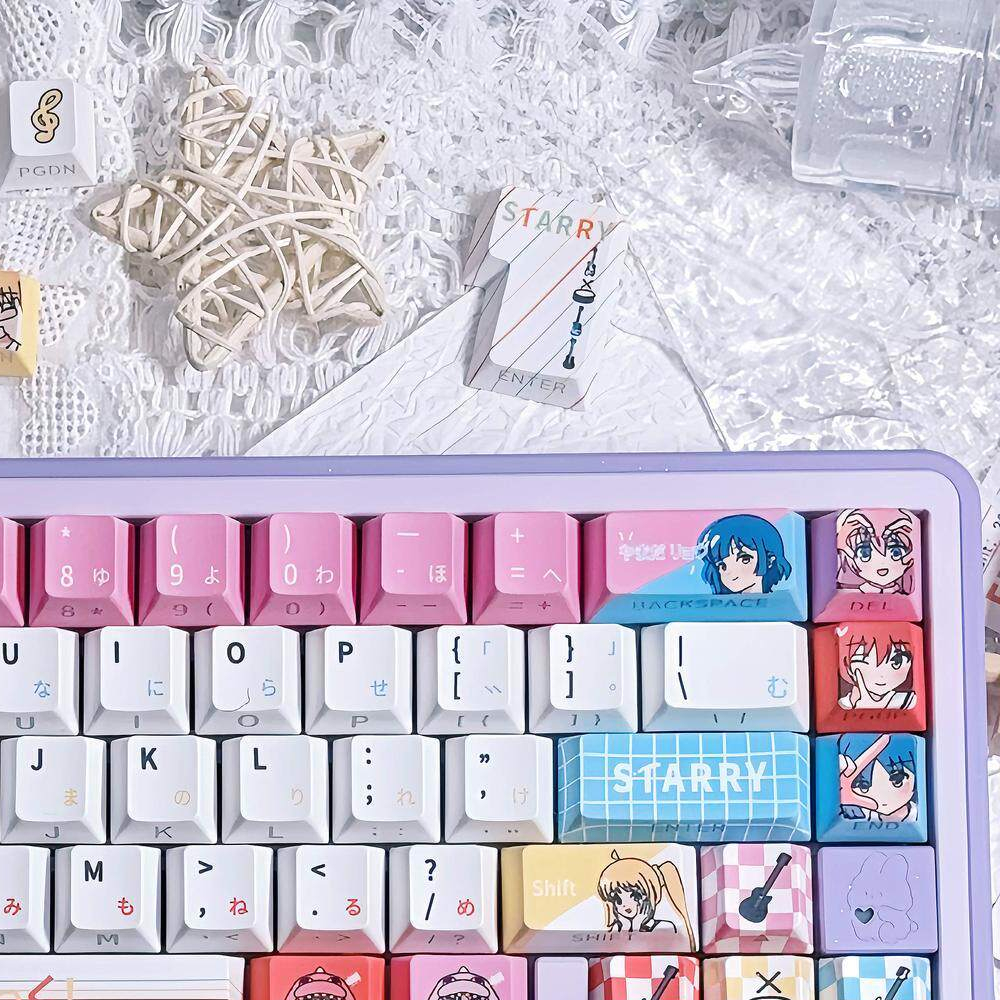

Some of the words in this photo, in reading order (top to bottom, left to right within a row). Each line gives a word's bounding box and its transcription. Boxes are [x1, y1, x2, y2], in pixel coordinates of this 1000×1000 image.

[20, 165, 75, 177] PGDN
[61, 566, 73, 587] 8
[93, 568, 109, 586] ゆ
[171, 564, 183, 585] 9
[205, 566, 219, 584] よ
[285, 564, 297, 585] 0
[316, 565, 333, 584] わ
[429, 565, 446, 583] ほ
[3, 643, 18, 665] U
[114, 641, 119, 663] I
[227, 642, 245, 664] O
[339, 642, 353, 663] P
[34, 681, 50, 697] な
[148, 680, 163, 696] に
[263, 679, 275, 696] ら
[370, 680, 387, 696] せ
[768, 676, 788, 698] む
[31, 749, 42, 771] J
[141, 747, 157, 770] K
[254, 748, 266, 770] L
[612, 760, 769, 795] STARRY
[175, 791, 190, 805] の
[85, 861, 103, 882] M
[531, 877, 578, 899] Shift
[4, 899, 21, 915] み
[118, 898, 133, 915] も
[230, 898, 248, 915] ね
[346, 899, 360, 916] る
[457, 899, 474, 916] め
